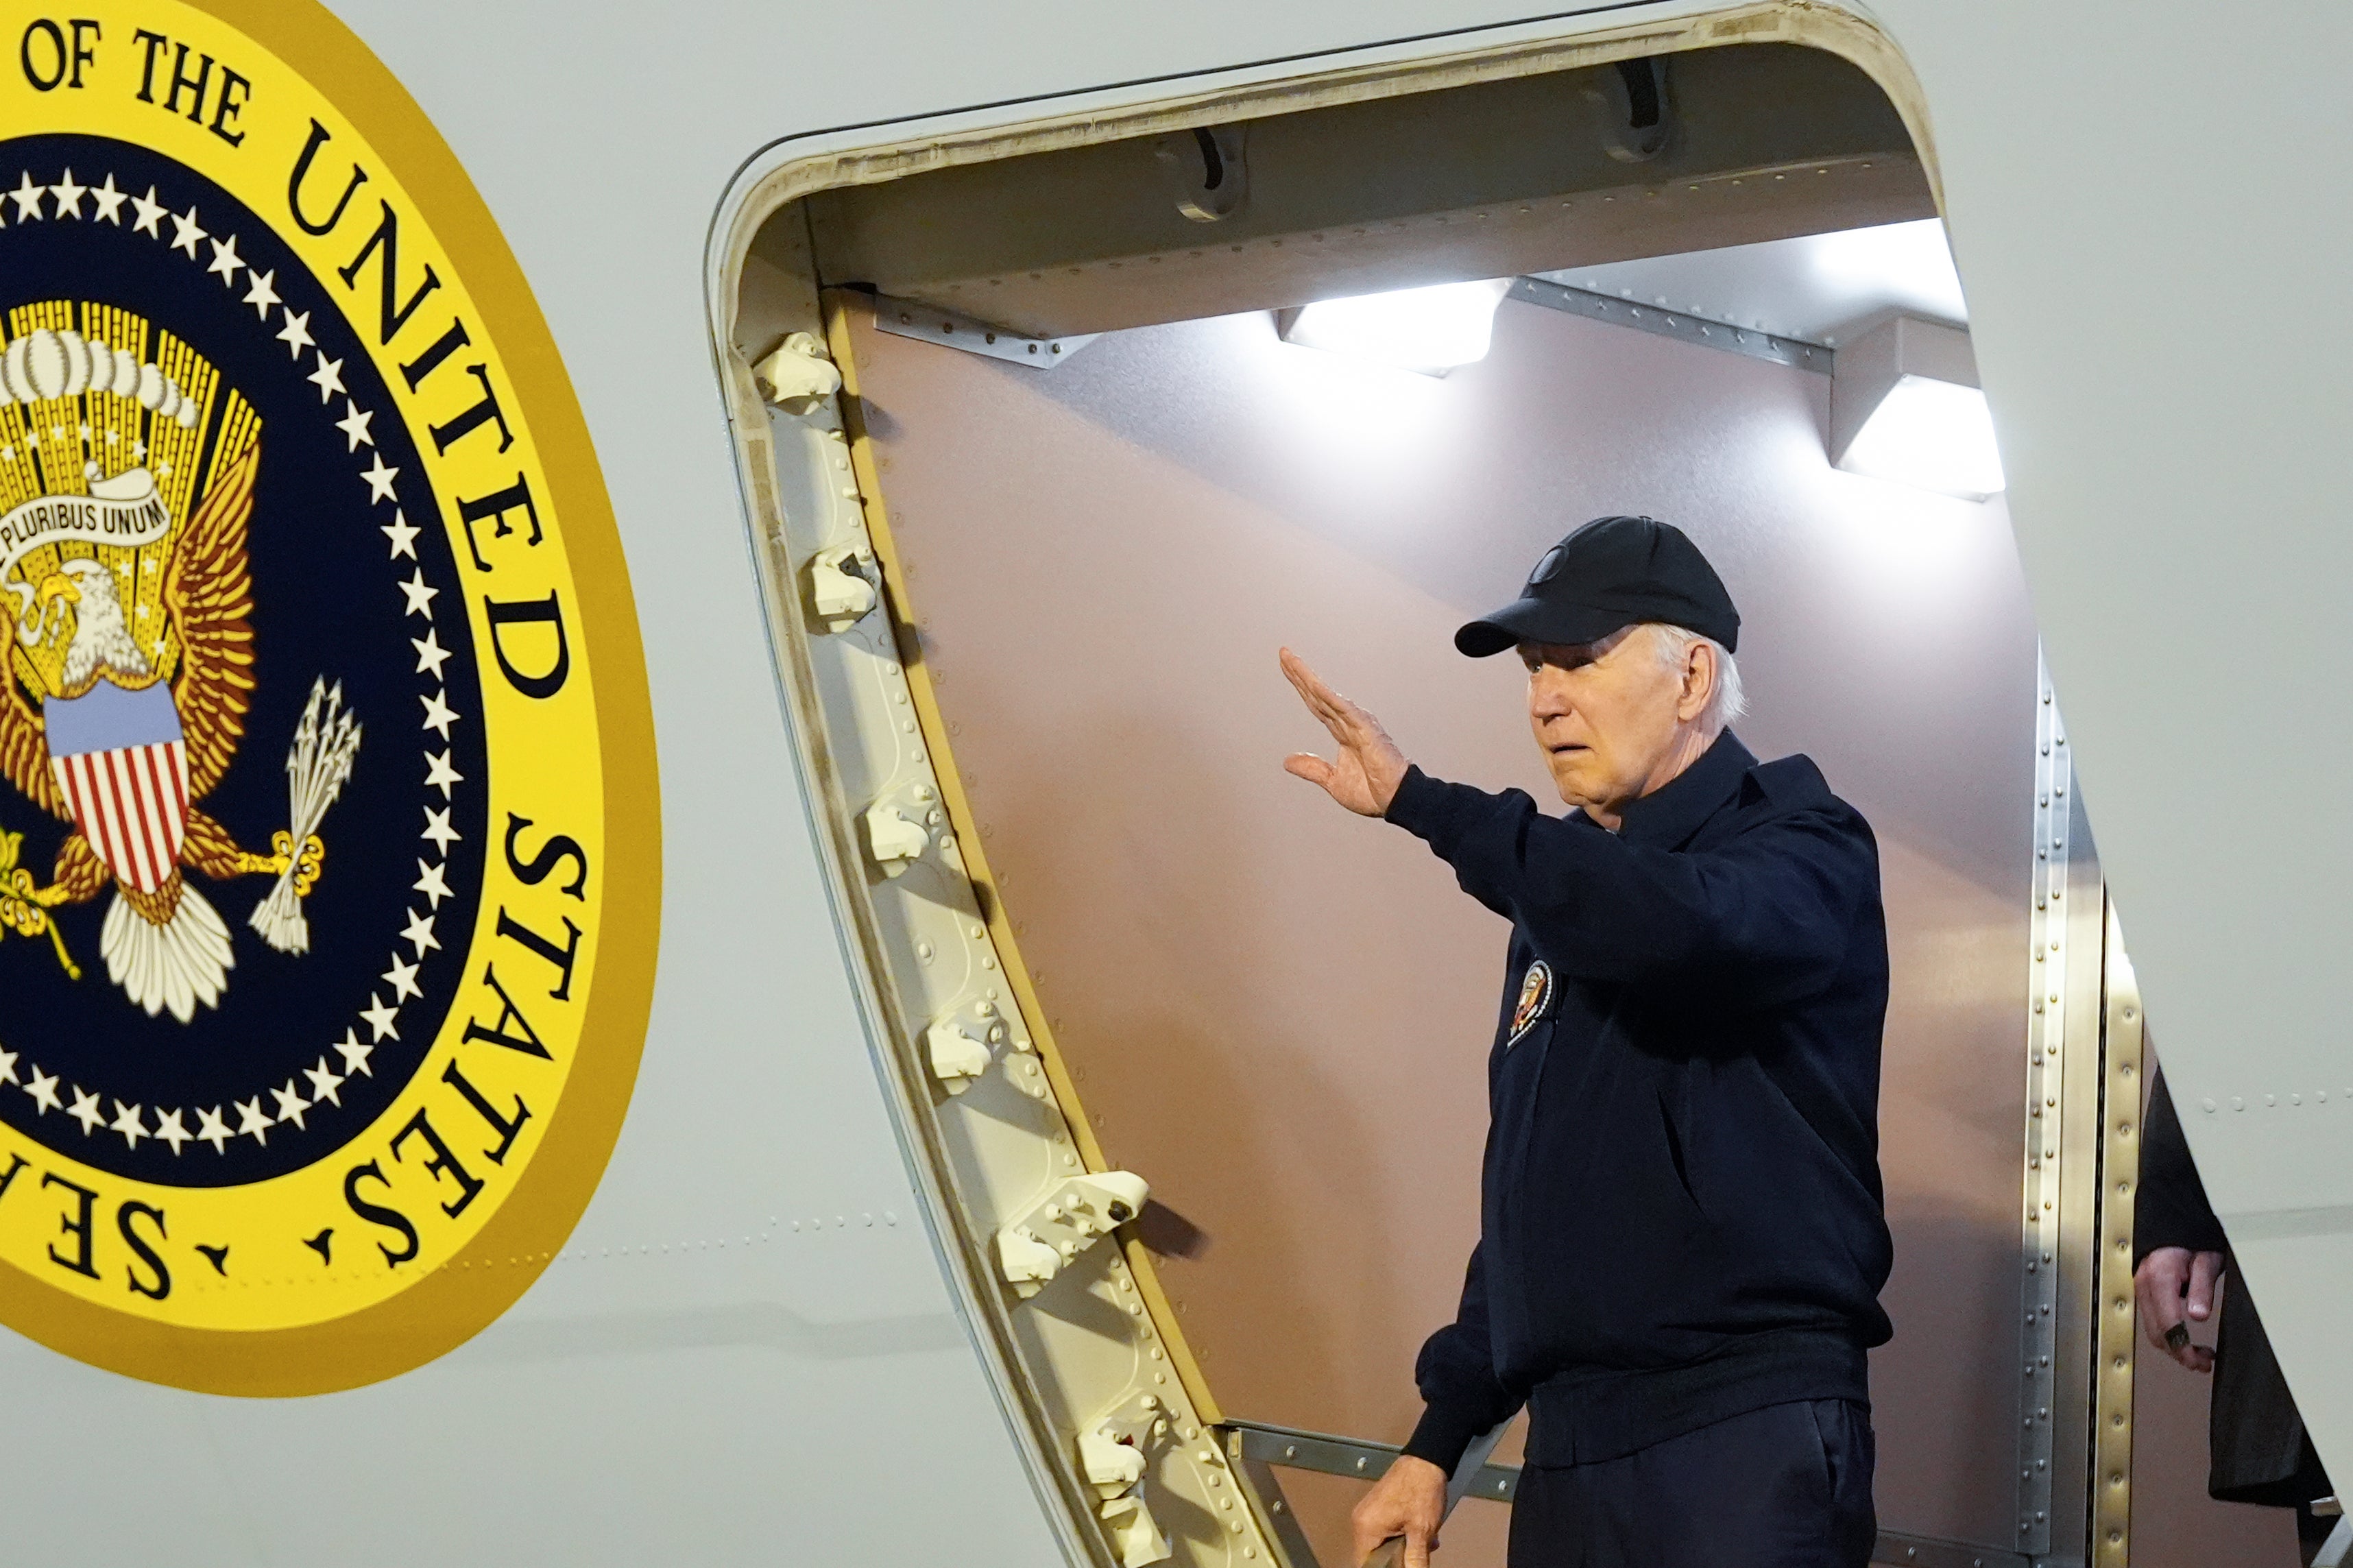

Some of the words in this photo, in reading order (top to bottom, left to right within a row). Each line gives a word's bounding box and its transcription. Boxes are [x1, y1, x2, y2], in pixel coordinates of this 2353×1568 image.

[21, 19, 101, 92] OF
[132, 28, 251, 149] THE
[287, 117, 570, 700] UNITED
[1, 504, 97, 551] PLURIBUS
[104, 498, 166, 535] UNUM
[343, 811, 588, 1270] STATES
